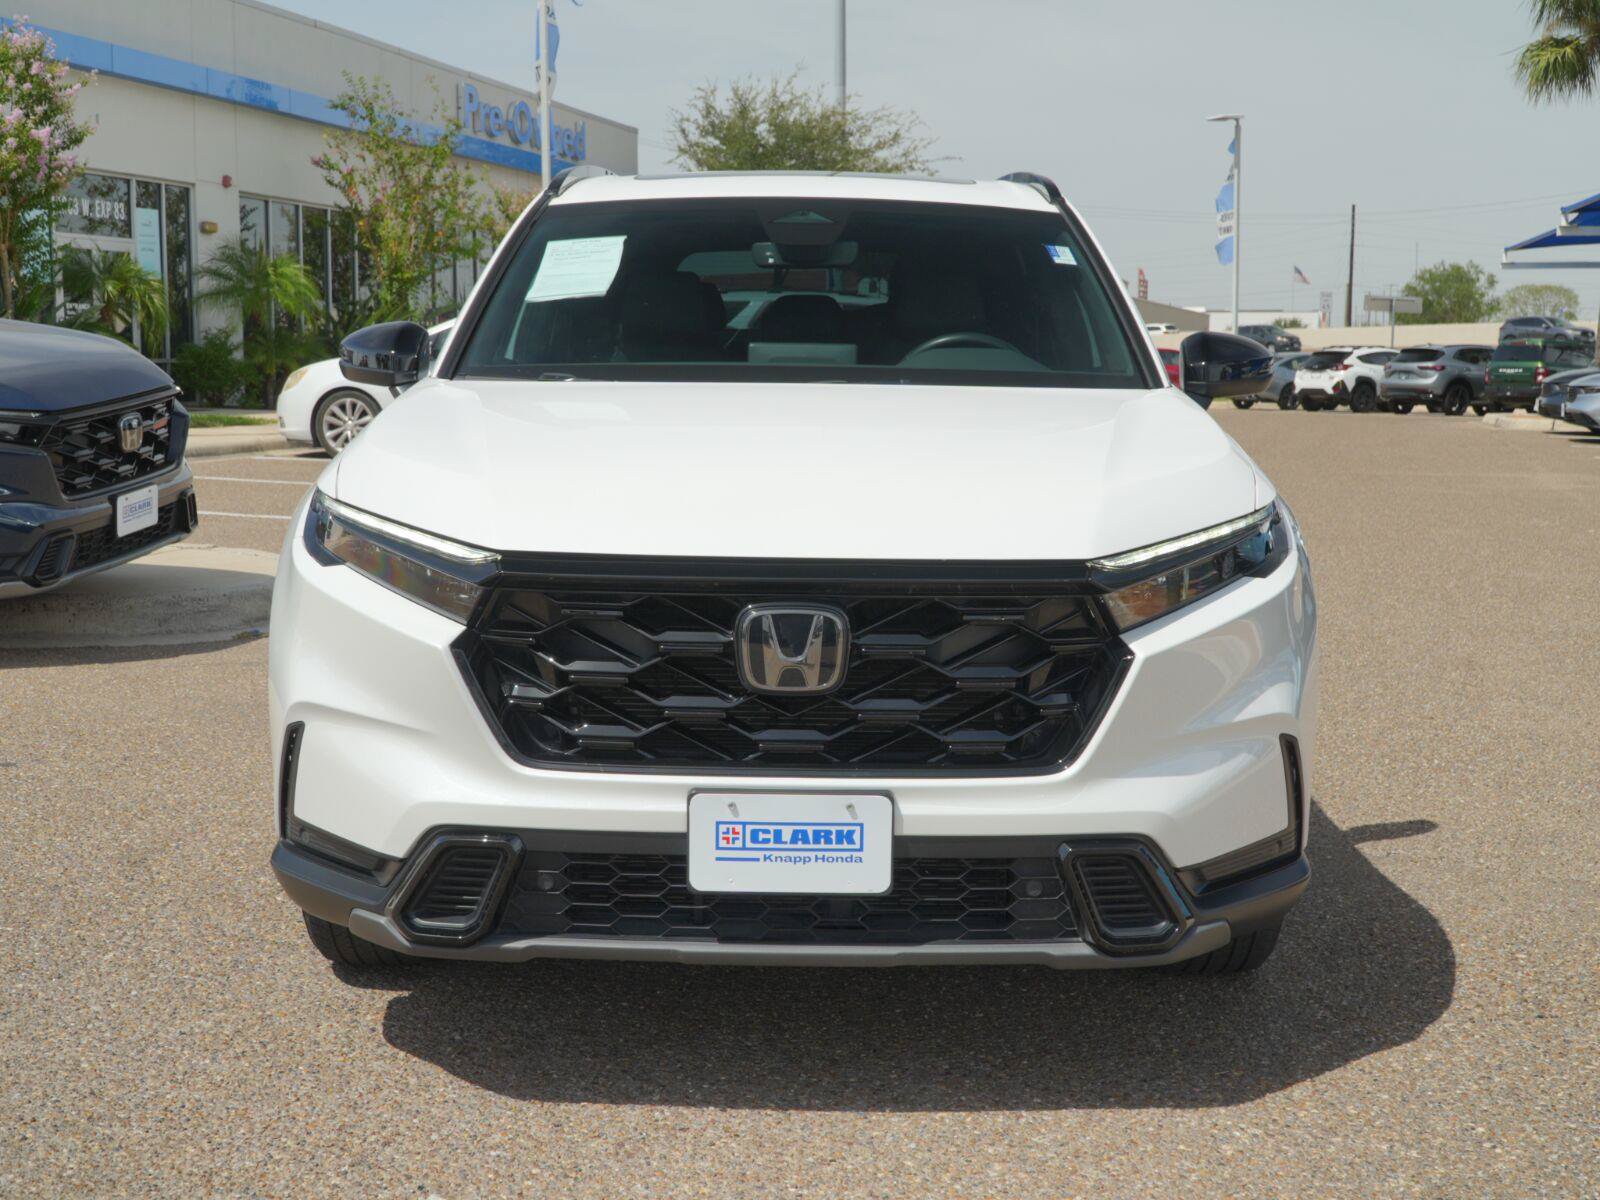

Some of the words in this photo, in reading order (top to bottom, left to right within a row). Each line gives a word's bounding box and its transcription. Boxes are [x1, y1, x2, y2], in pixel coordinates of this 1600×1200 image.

[95, 199, 112, 219] EXP
[114, 201, 126, 221] 83
[749, 828, 857, 846] CLARK
[762, 853, 812, 865] Knapp
[814, 854, 863, 864] Honda
